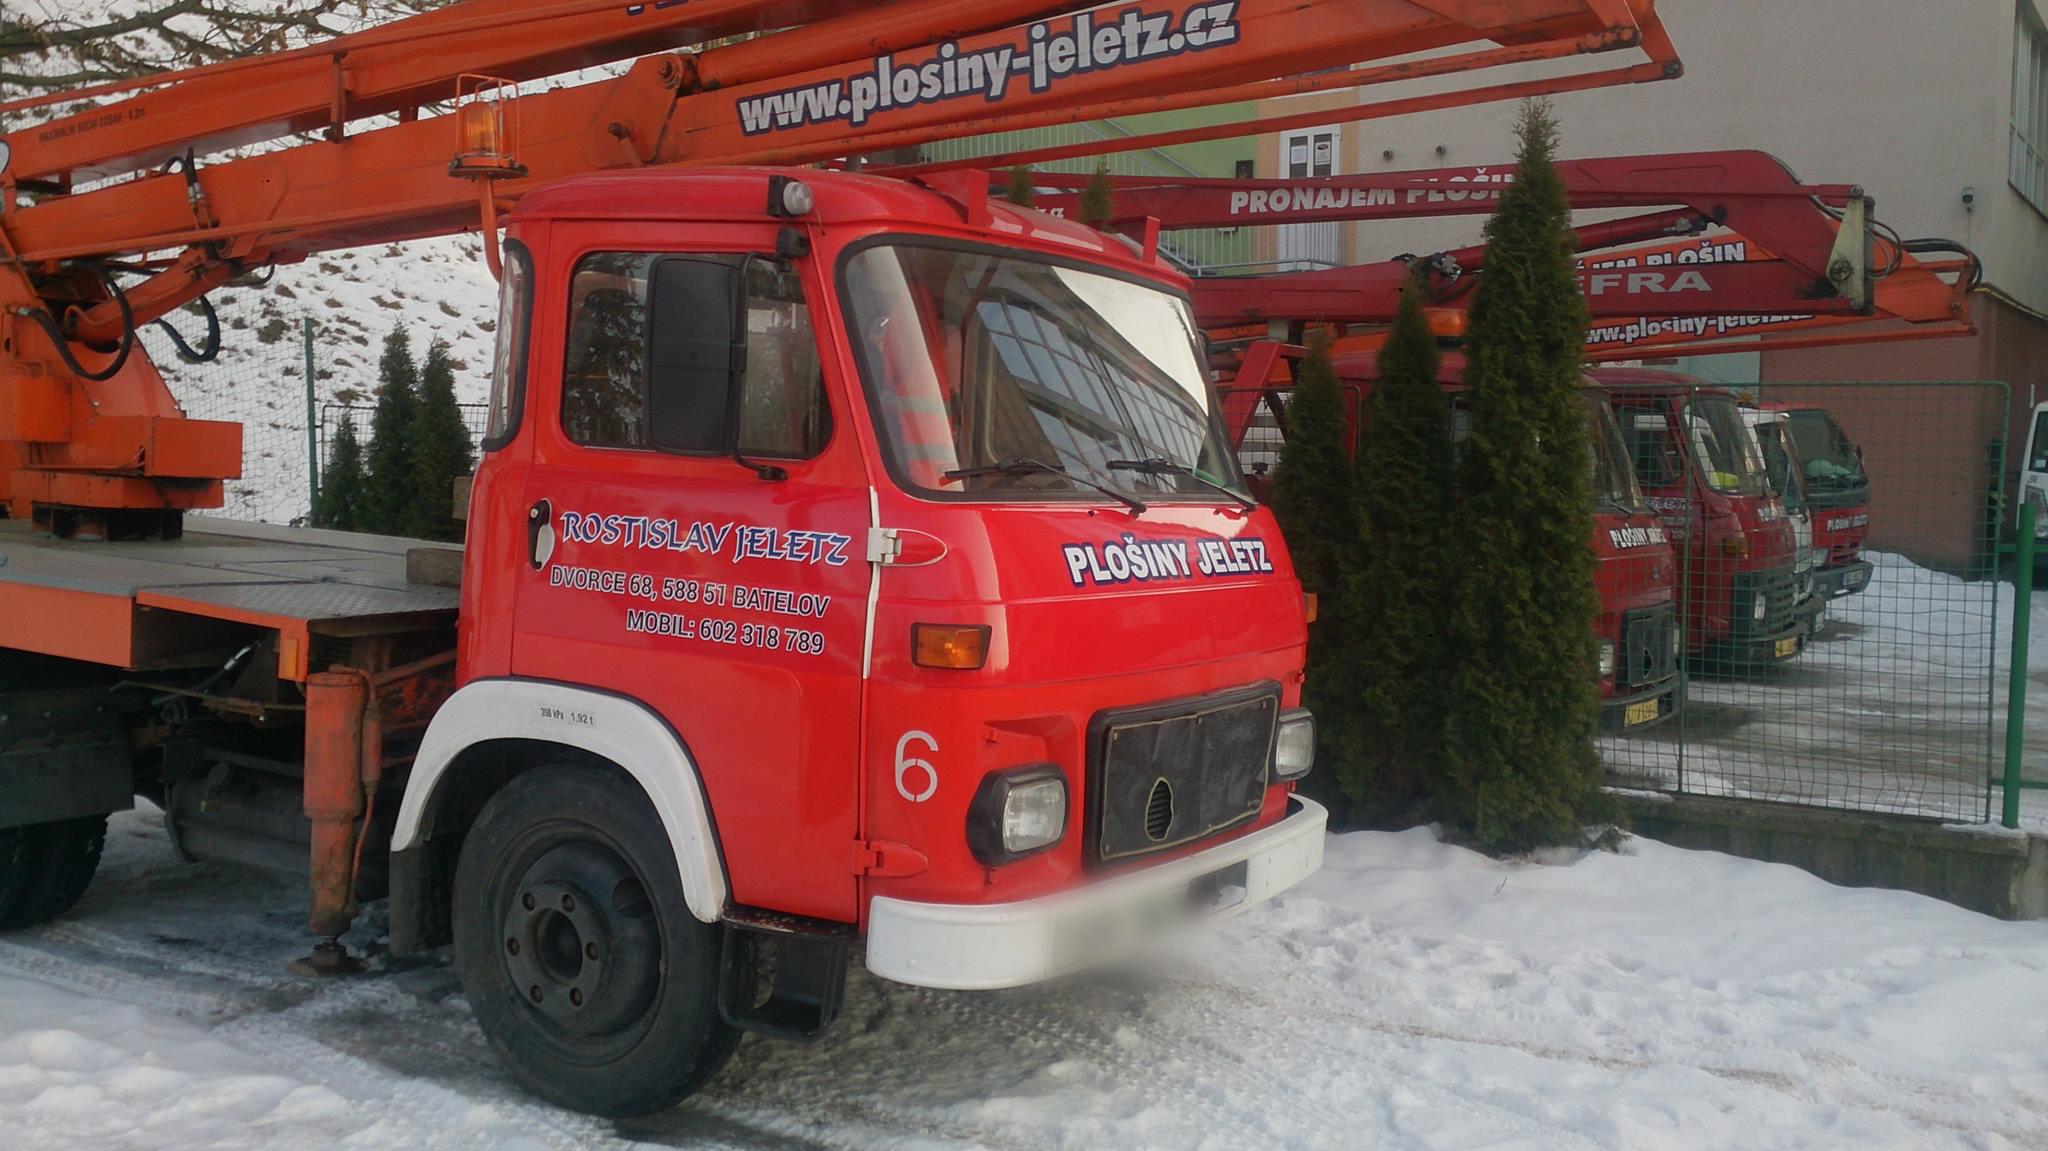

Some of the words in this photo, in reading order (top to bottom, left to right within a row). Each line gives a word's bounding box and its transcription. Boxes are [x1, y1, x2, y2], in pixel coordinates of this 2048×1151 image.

[738, 0, 1239, 135] www.plosiny-jeletz.cz
[560, 511, 734, 555] ROSTISLAV
[733, 524, 851, 566] JELETZ
[1063, 534, 1192, 586] PLOŠINY
[1197, 538, 1273, 576] JELETZ
[550, 566, 625, 594] DVORCE
[629, 574, 657, 602] 68,
[663, 578, 698, 603] 588
[703, 582, 727, 606] 51
[732, 586, 830, 618] BATELOV
[626, 609, 695, 638] MOBIL:
[699, 619, 736, 644] 602
[741, 624, 778, 650] 318
[785, 629, 824, 655] 789
[894, 730, 939, 803] 6
